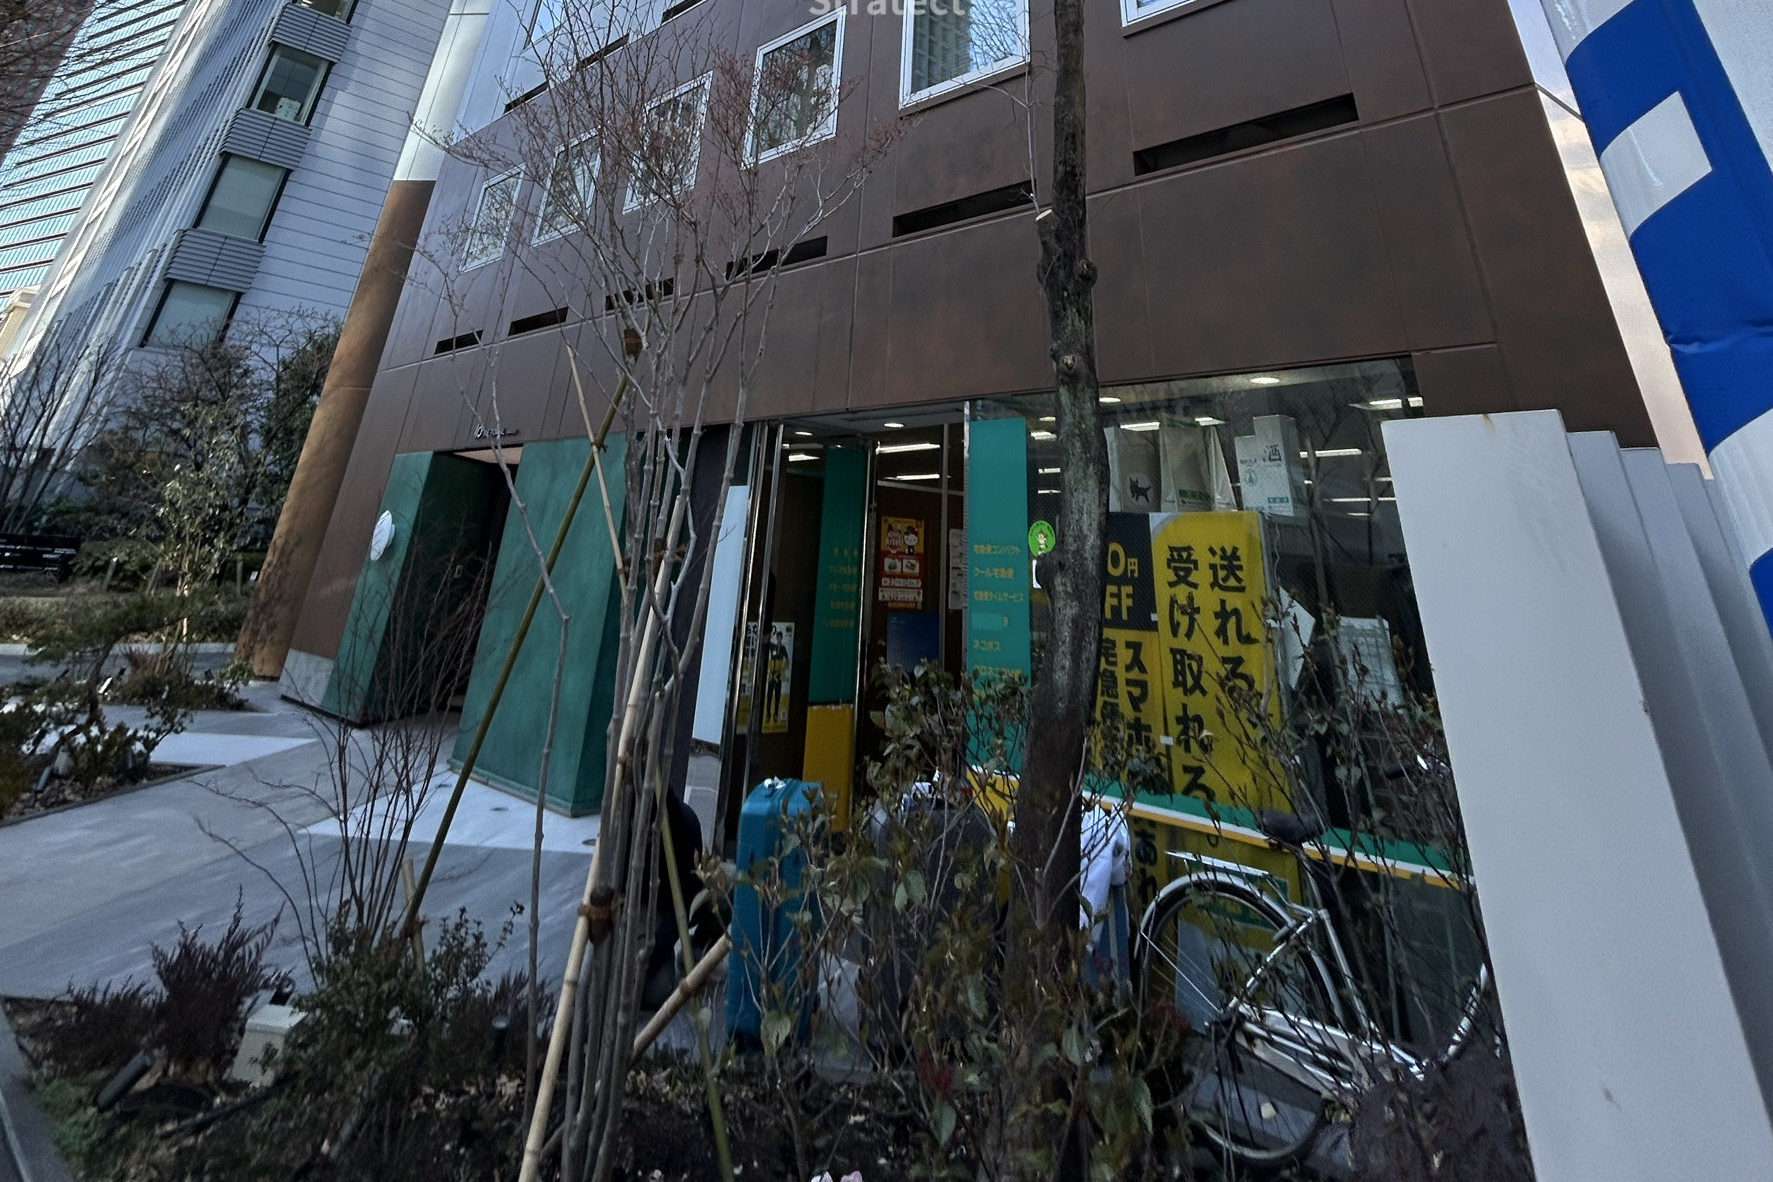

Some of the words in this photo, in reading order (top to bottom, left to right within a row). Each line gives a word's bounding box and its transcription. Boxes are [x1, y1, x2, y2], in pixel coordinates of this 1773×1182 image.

[1262, 443, 1282, 462] 酒
[974, 567, 1014, 578] クール宅急便
[1107, 542, 1139, 578] 0円
[1104, 584, 1133, 620] FF
